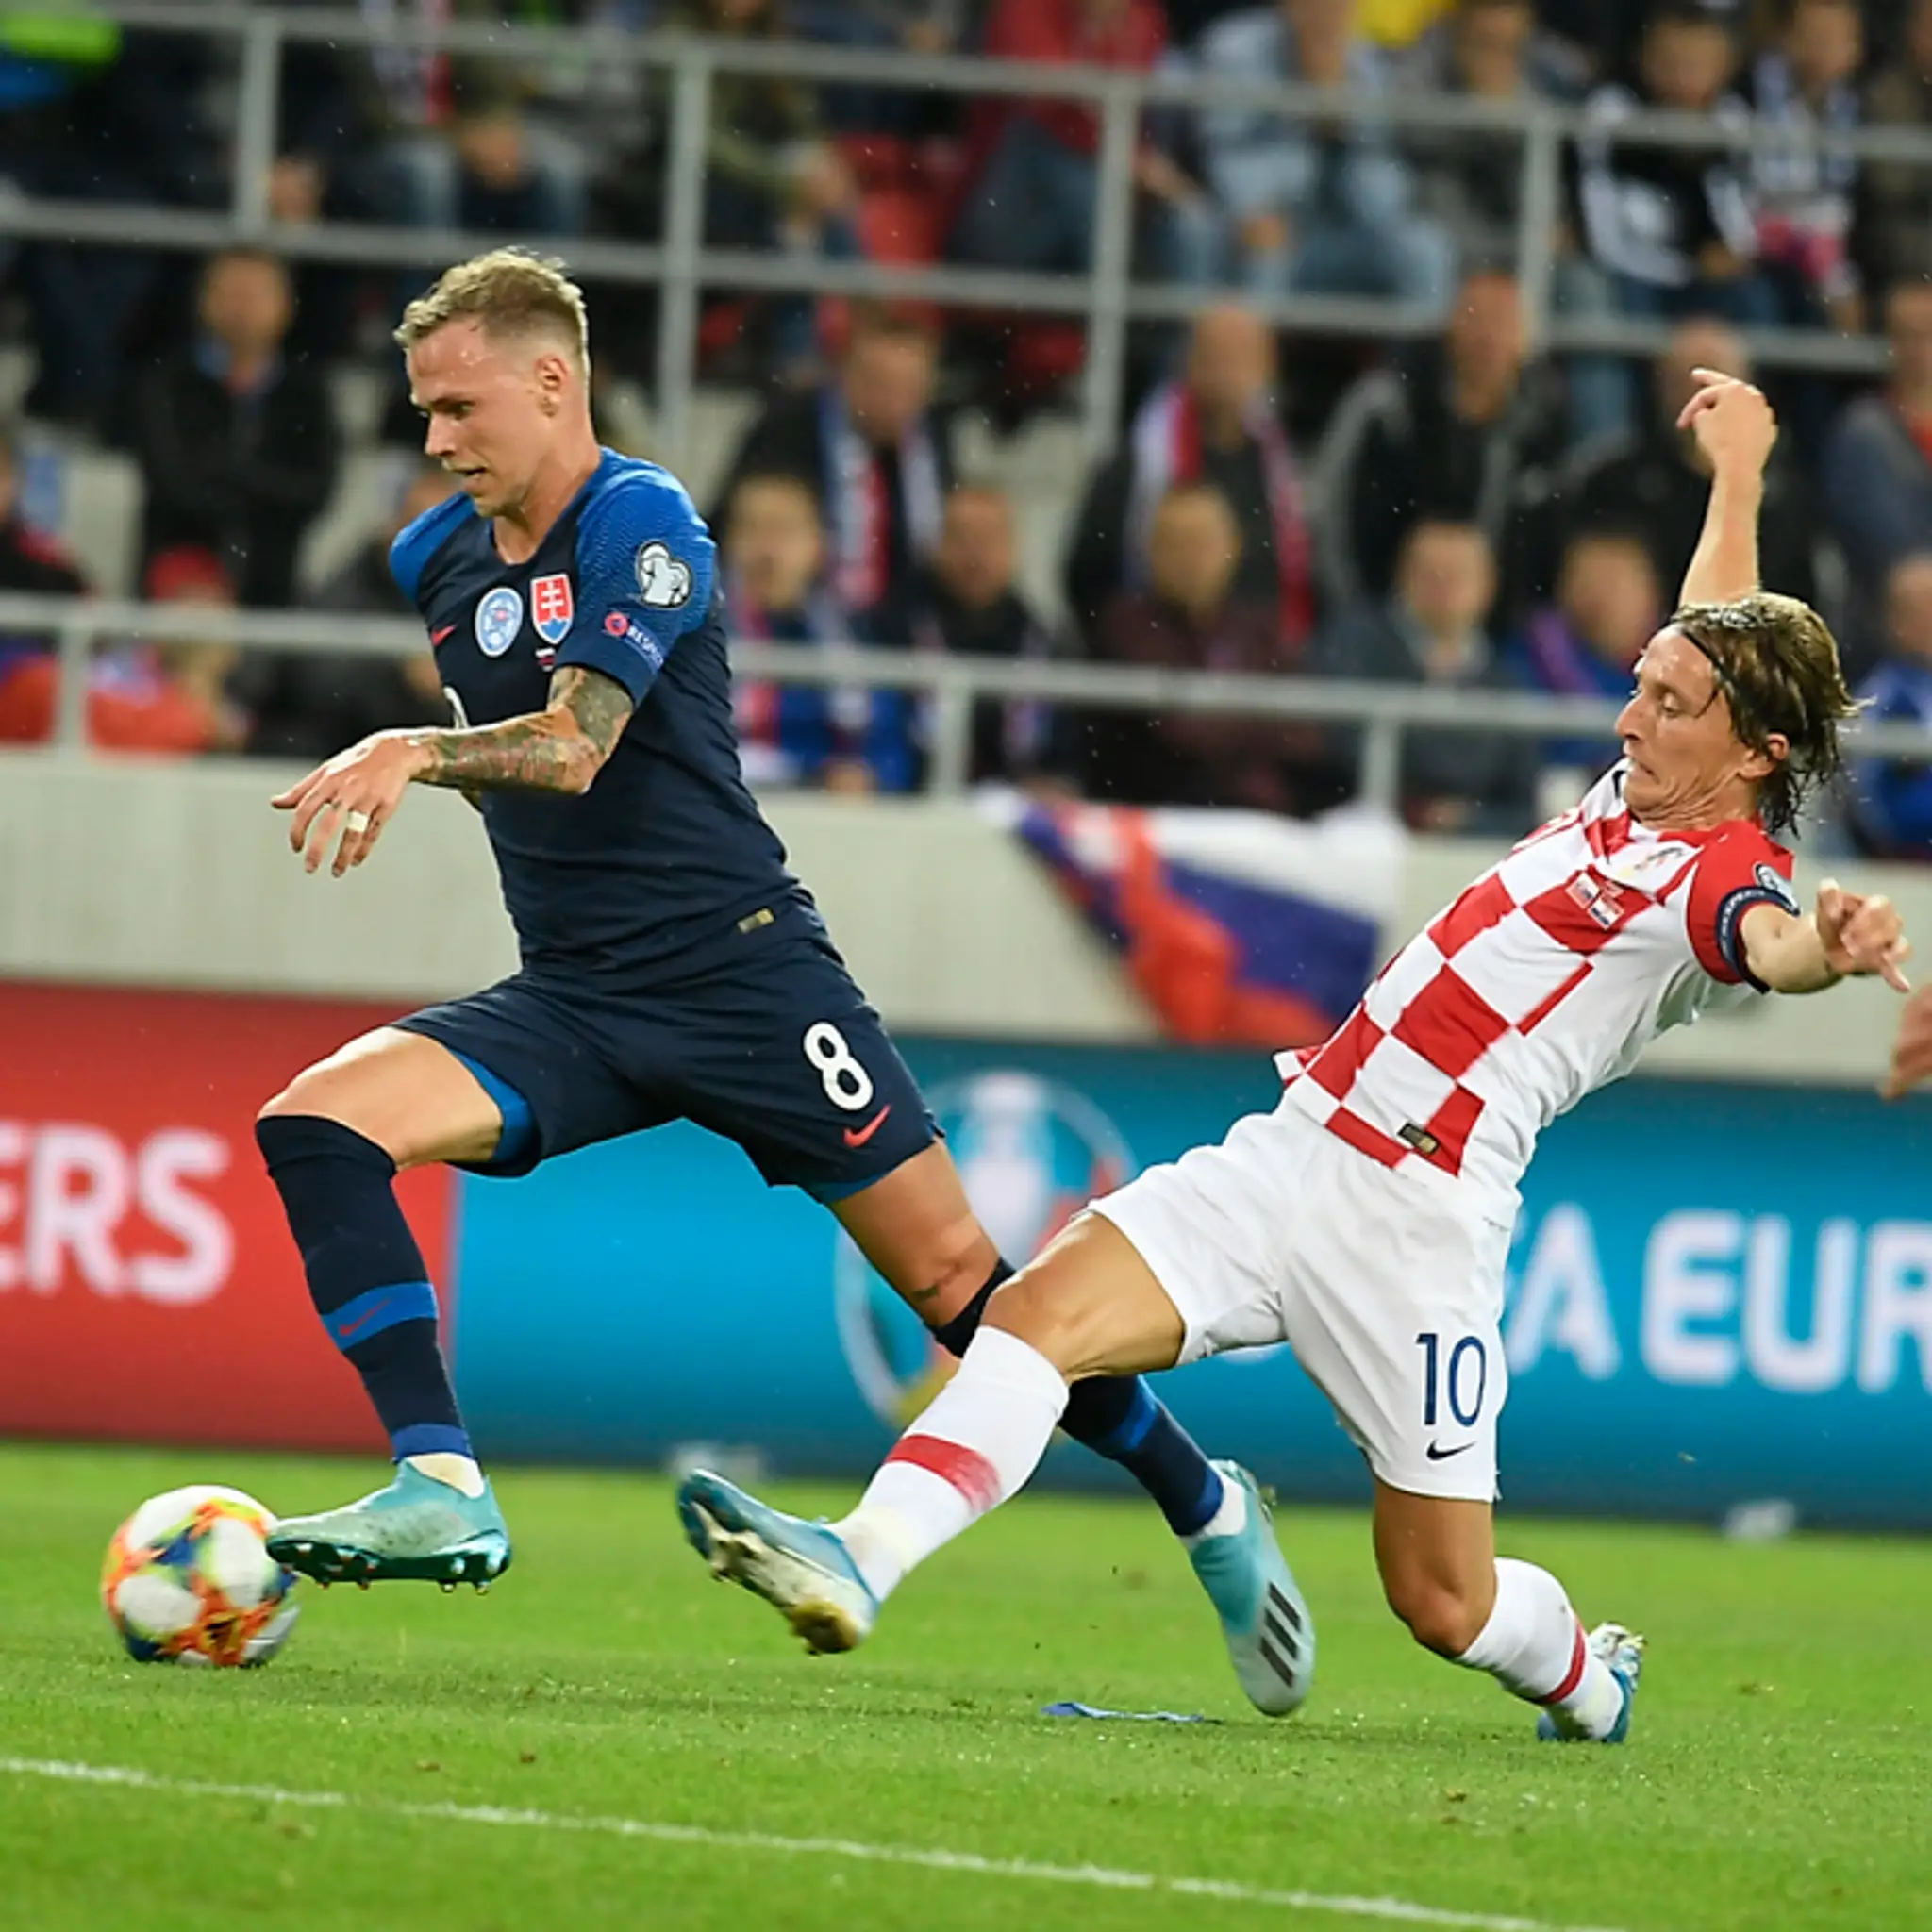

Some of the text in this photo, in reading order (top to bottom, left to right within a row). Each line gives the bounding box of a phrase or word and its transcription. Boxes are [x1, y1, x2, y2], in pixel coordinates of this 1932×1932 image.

[803, 1022, 874, 1111] 8
[0, 1120, 235, 1304] RS
[1505, 1201, 1622, 1381] A
[1415, 1332, 1487, 1428] 10
